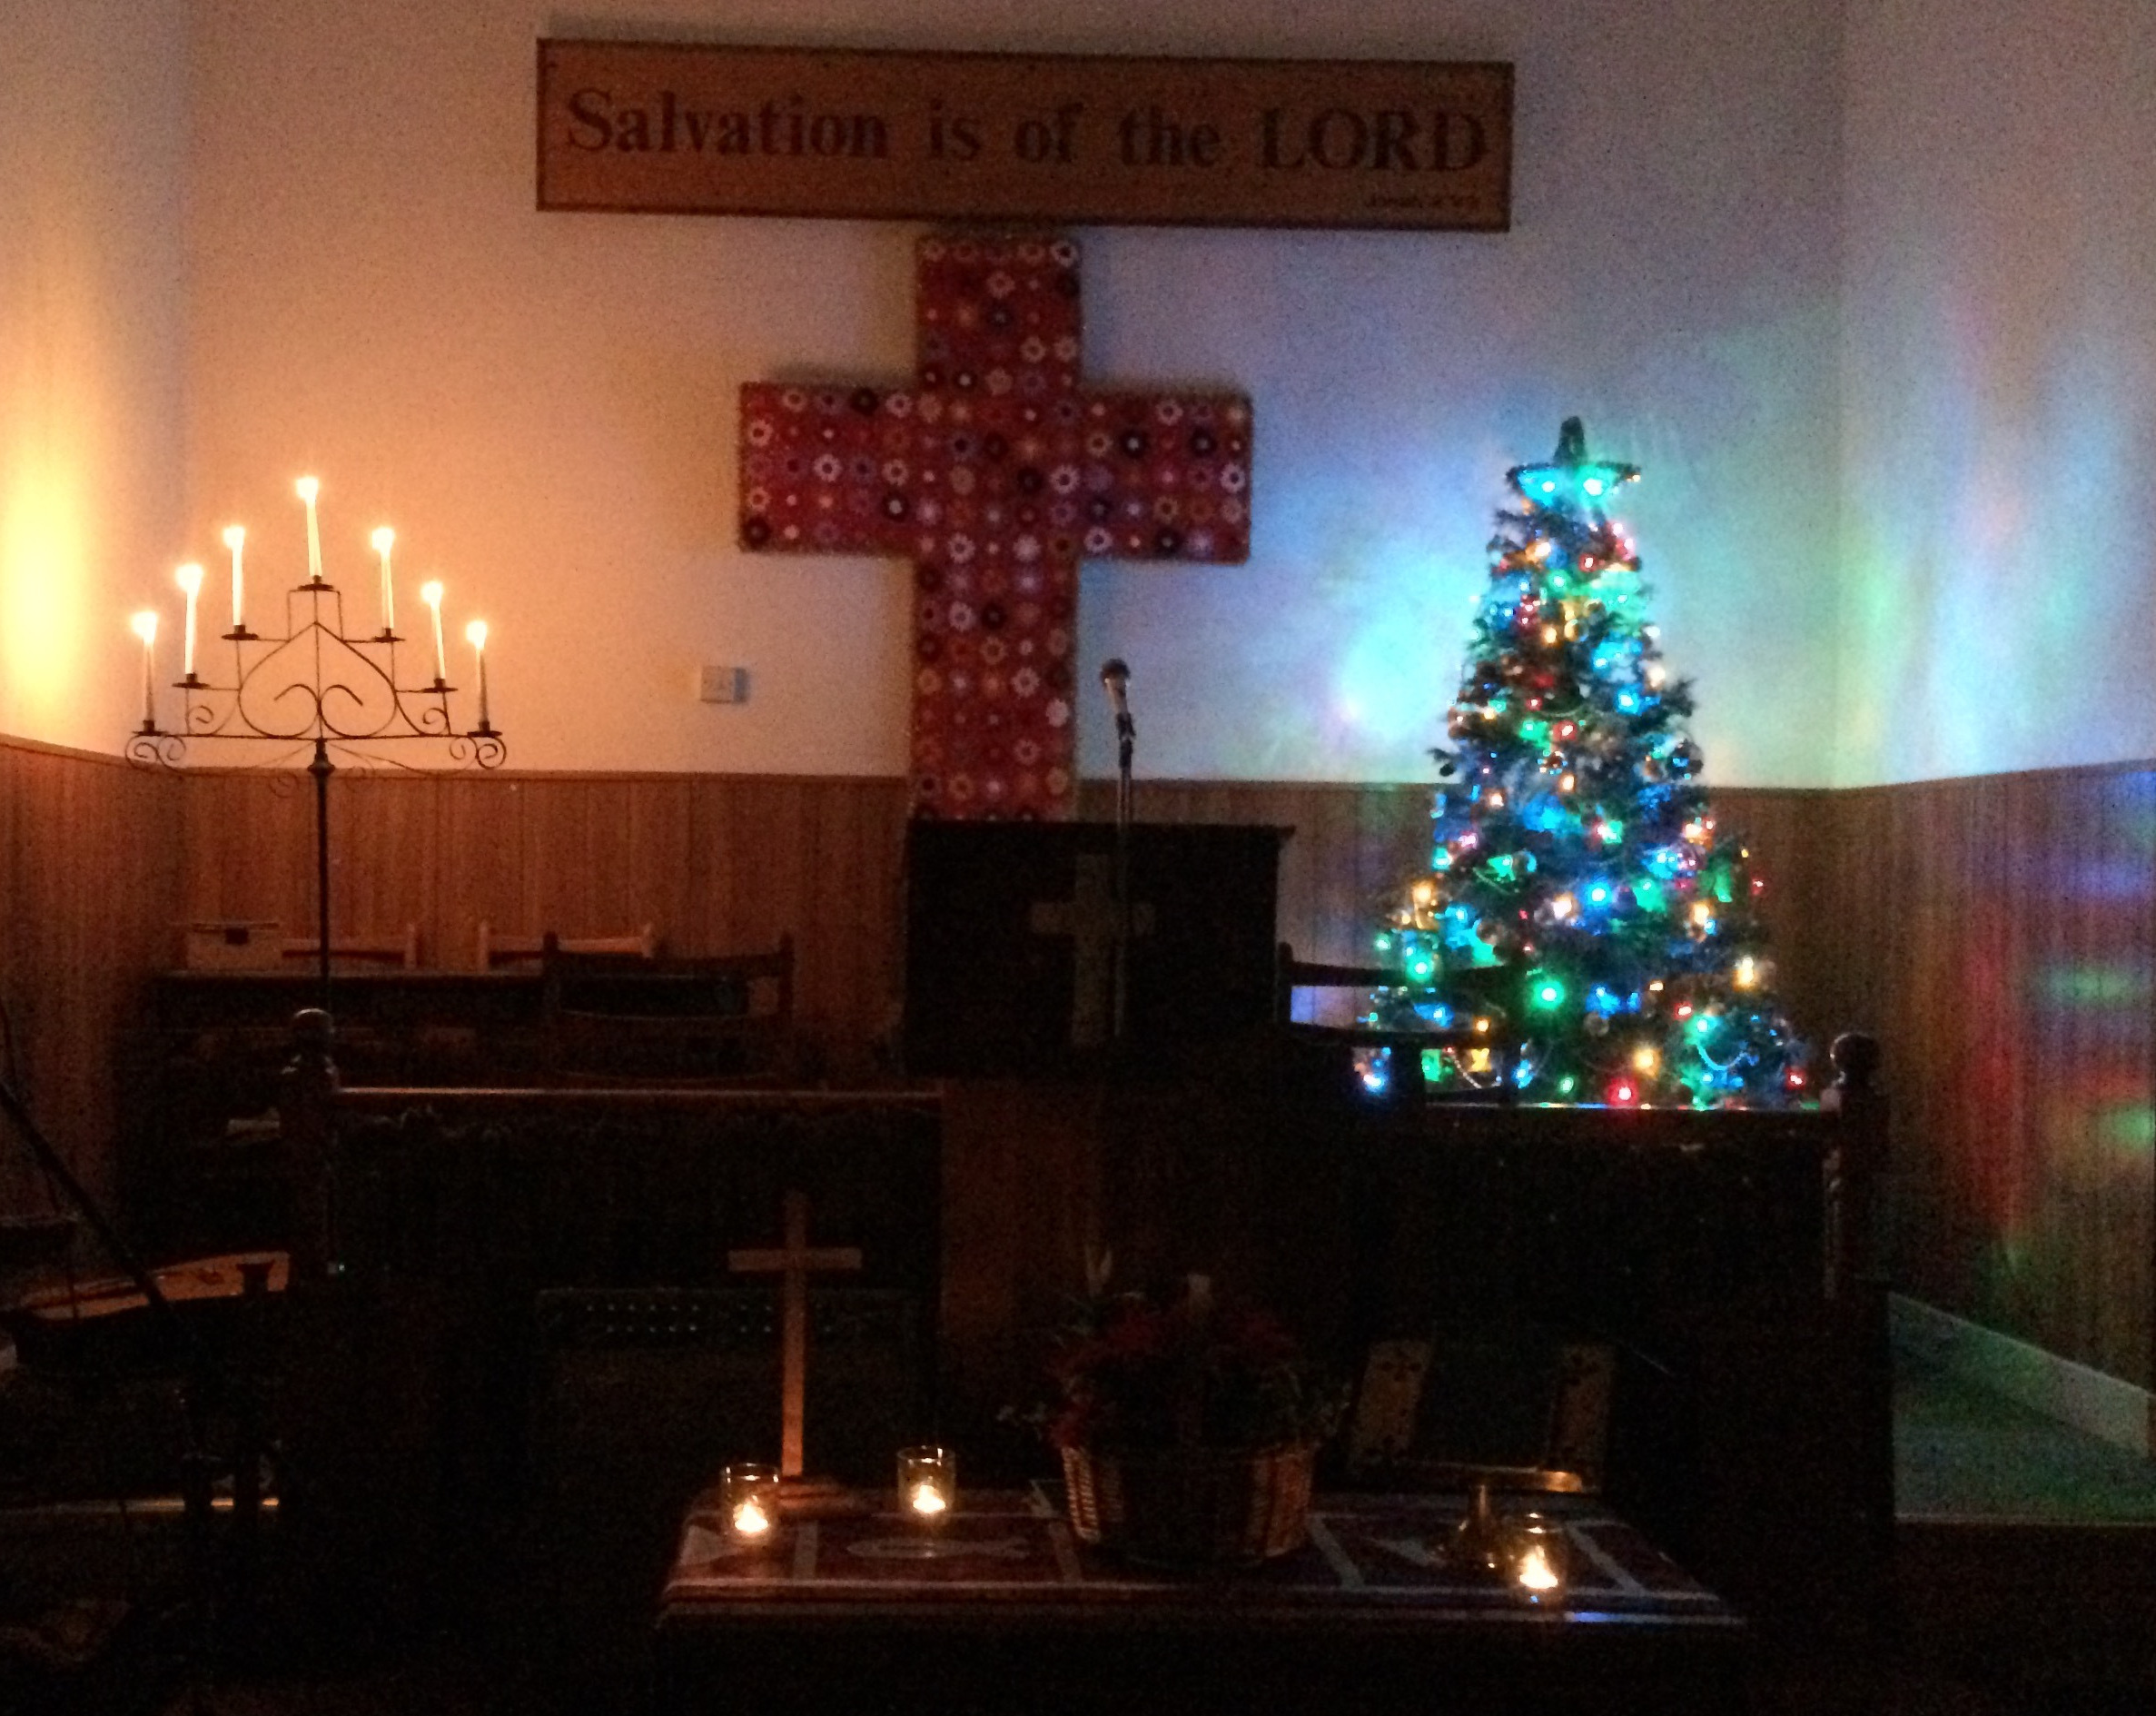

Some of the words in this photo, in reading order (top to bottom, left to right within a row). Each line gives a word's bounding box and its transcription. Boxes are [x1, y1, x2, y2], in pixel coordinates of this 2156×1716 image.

[568, 88, 890, 160] Salvation
[929, 98, 983, 162] is
[1014, 102, 1084, 164] of
[1118, 105, 1221, 168] the
[1260, 105, 1489, 173] LORD
